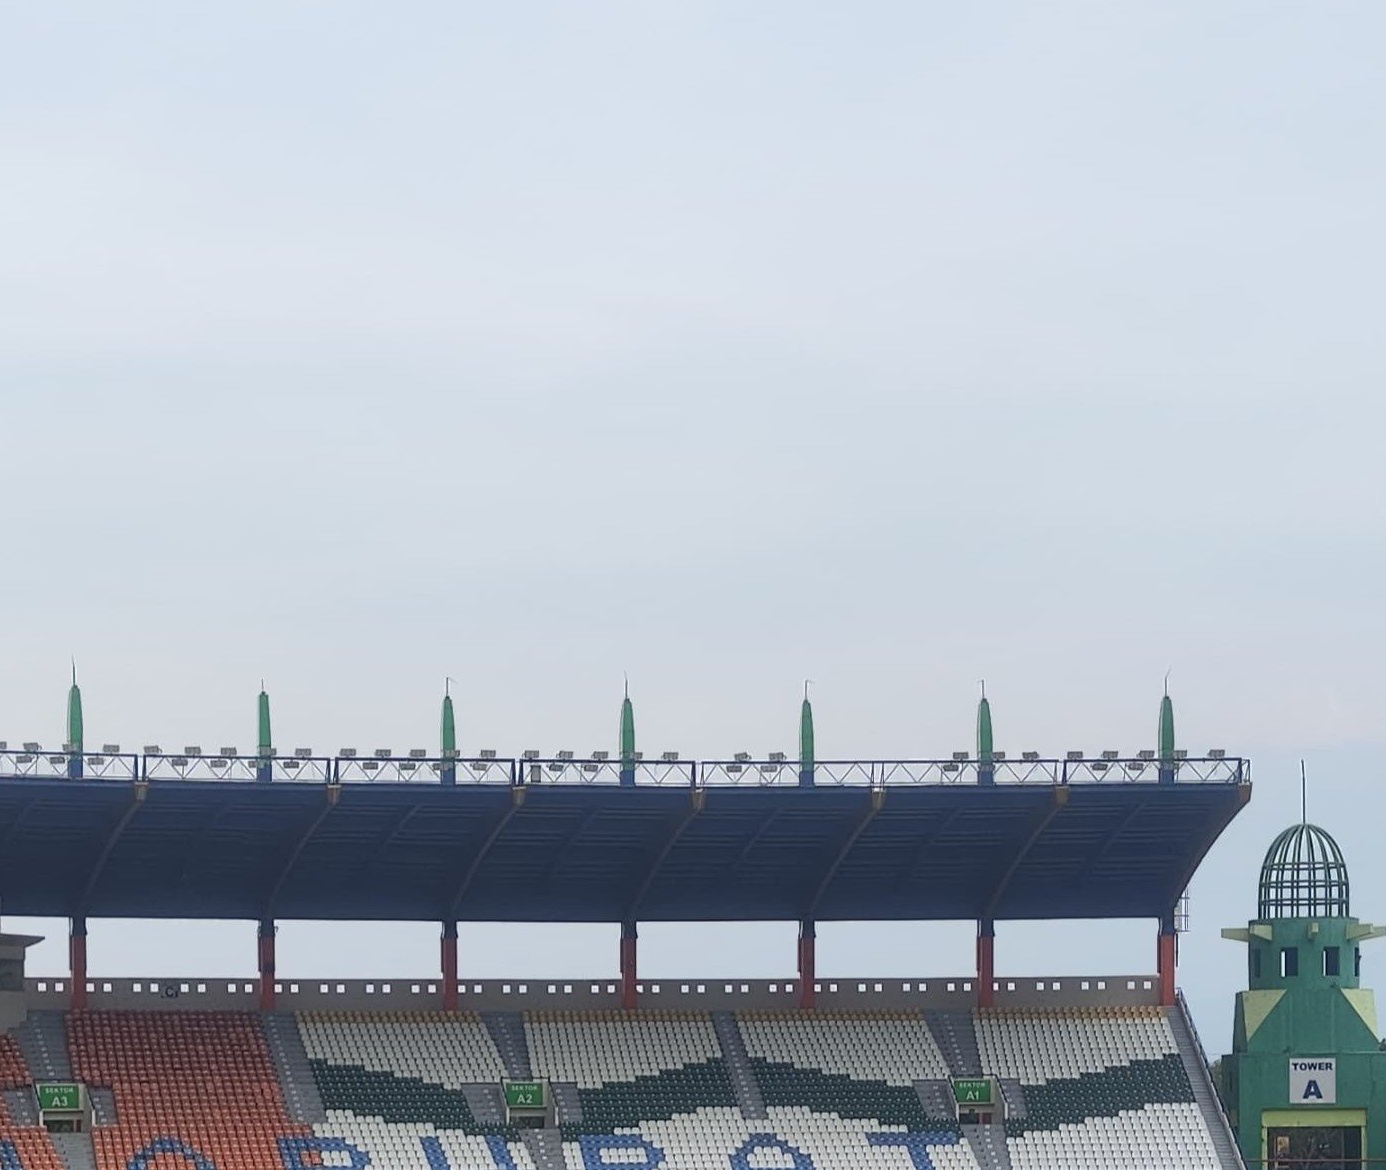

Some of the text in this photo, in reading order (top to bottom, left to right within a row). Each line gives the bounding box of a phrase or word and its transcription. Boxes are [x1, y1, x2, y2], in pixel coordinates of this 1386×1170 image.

[1291, 1061, 1333, 1071] TOWER
[966, 1090, 980, 1100] A1
[1302, 1079, 1323, 1100] A
[51, 1096, 68, 1107] A3
[516, 1093, 533, 1104] A2
